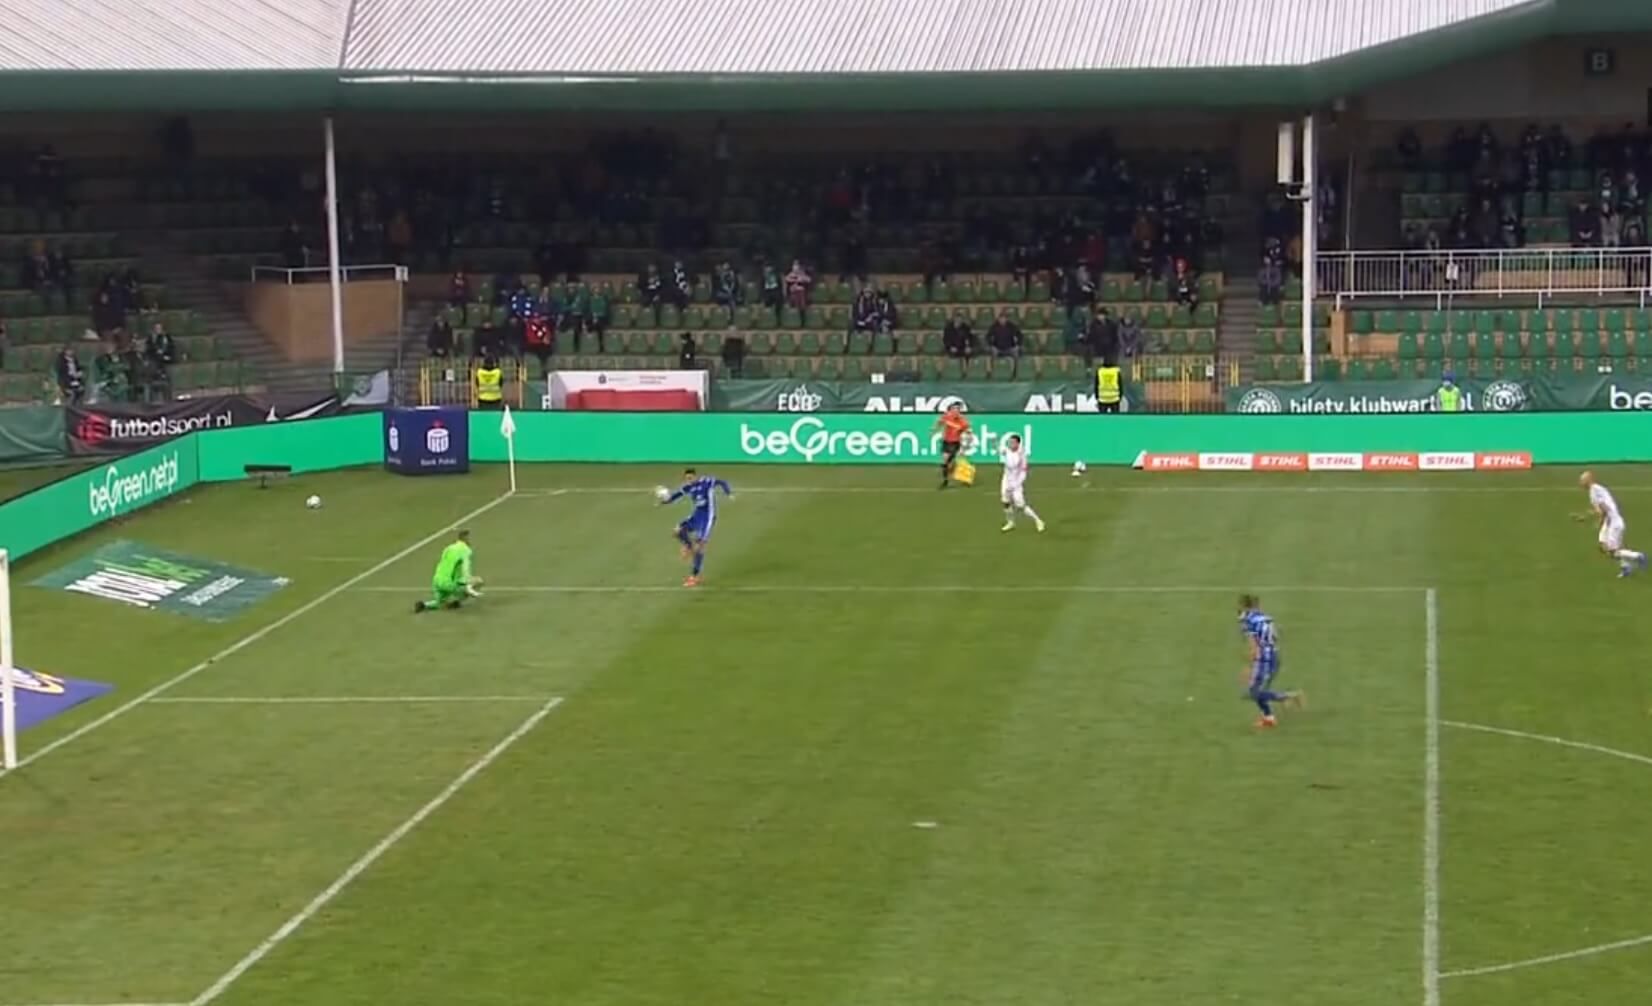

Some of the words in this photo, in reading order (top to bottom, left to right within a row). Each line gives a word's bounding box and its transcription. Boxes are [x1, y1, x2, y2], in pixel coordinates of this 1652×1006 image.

[1591, 52, 1608, 71] B
[110, 411, 232, 438] futbolsportpl
[1152, 456, 1193, 466] STIHL
[1207, 456, 1248, 466] STIHL
[1260, 456, 1301, 466] STIHL
[1314, 456, 1356, 466] STIHL
[1370, 455, 1412, 466] STIHL
[1426, 455, 1469, 465] STIHL
[1482, 455, 1524, 465] STIHL
